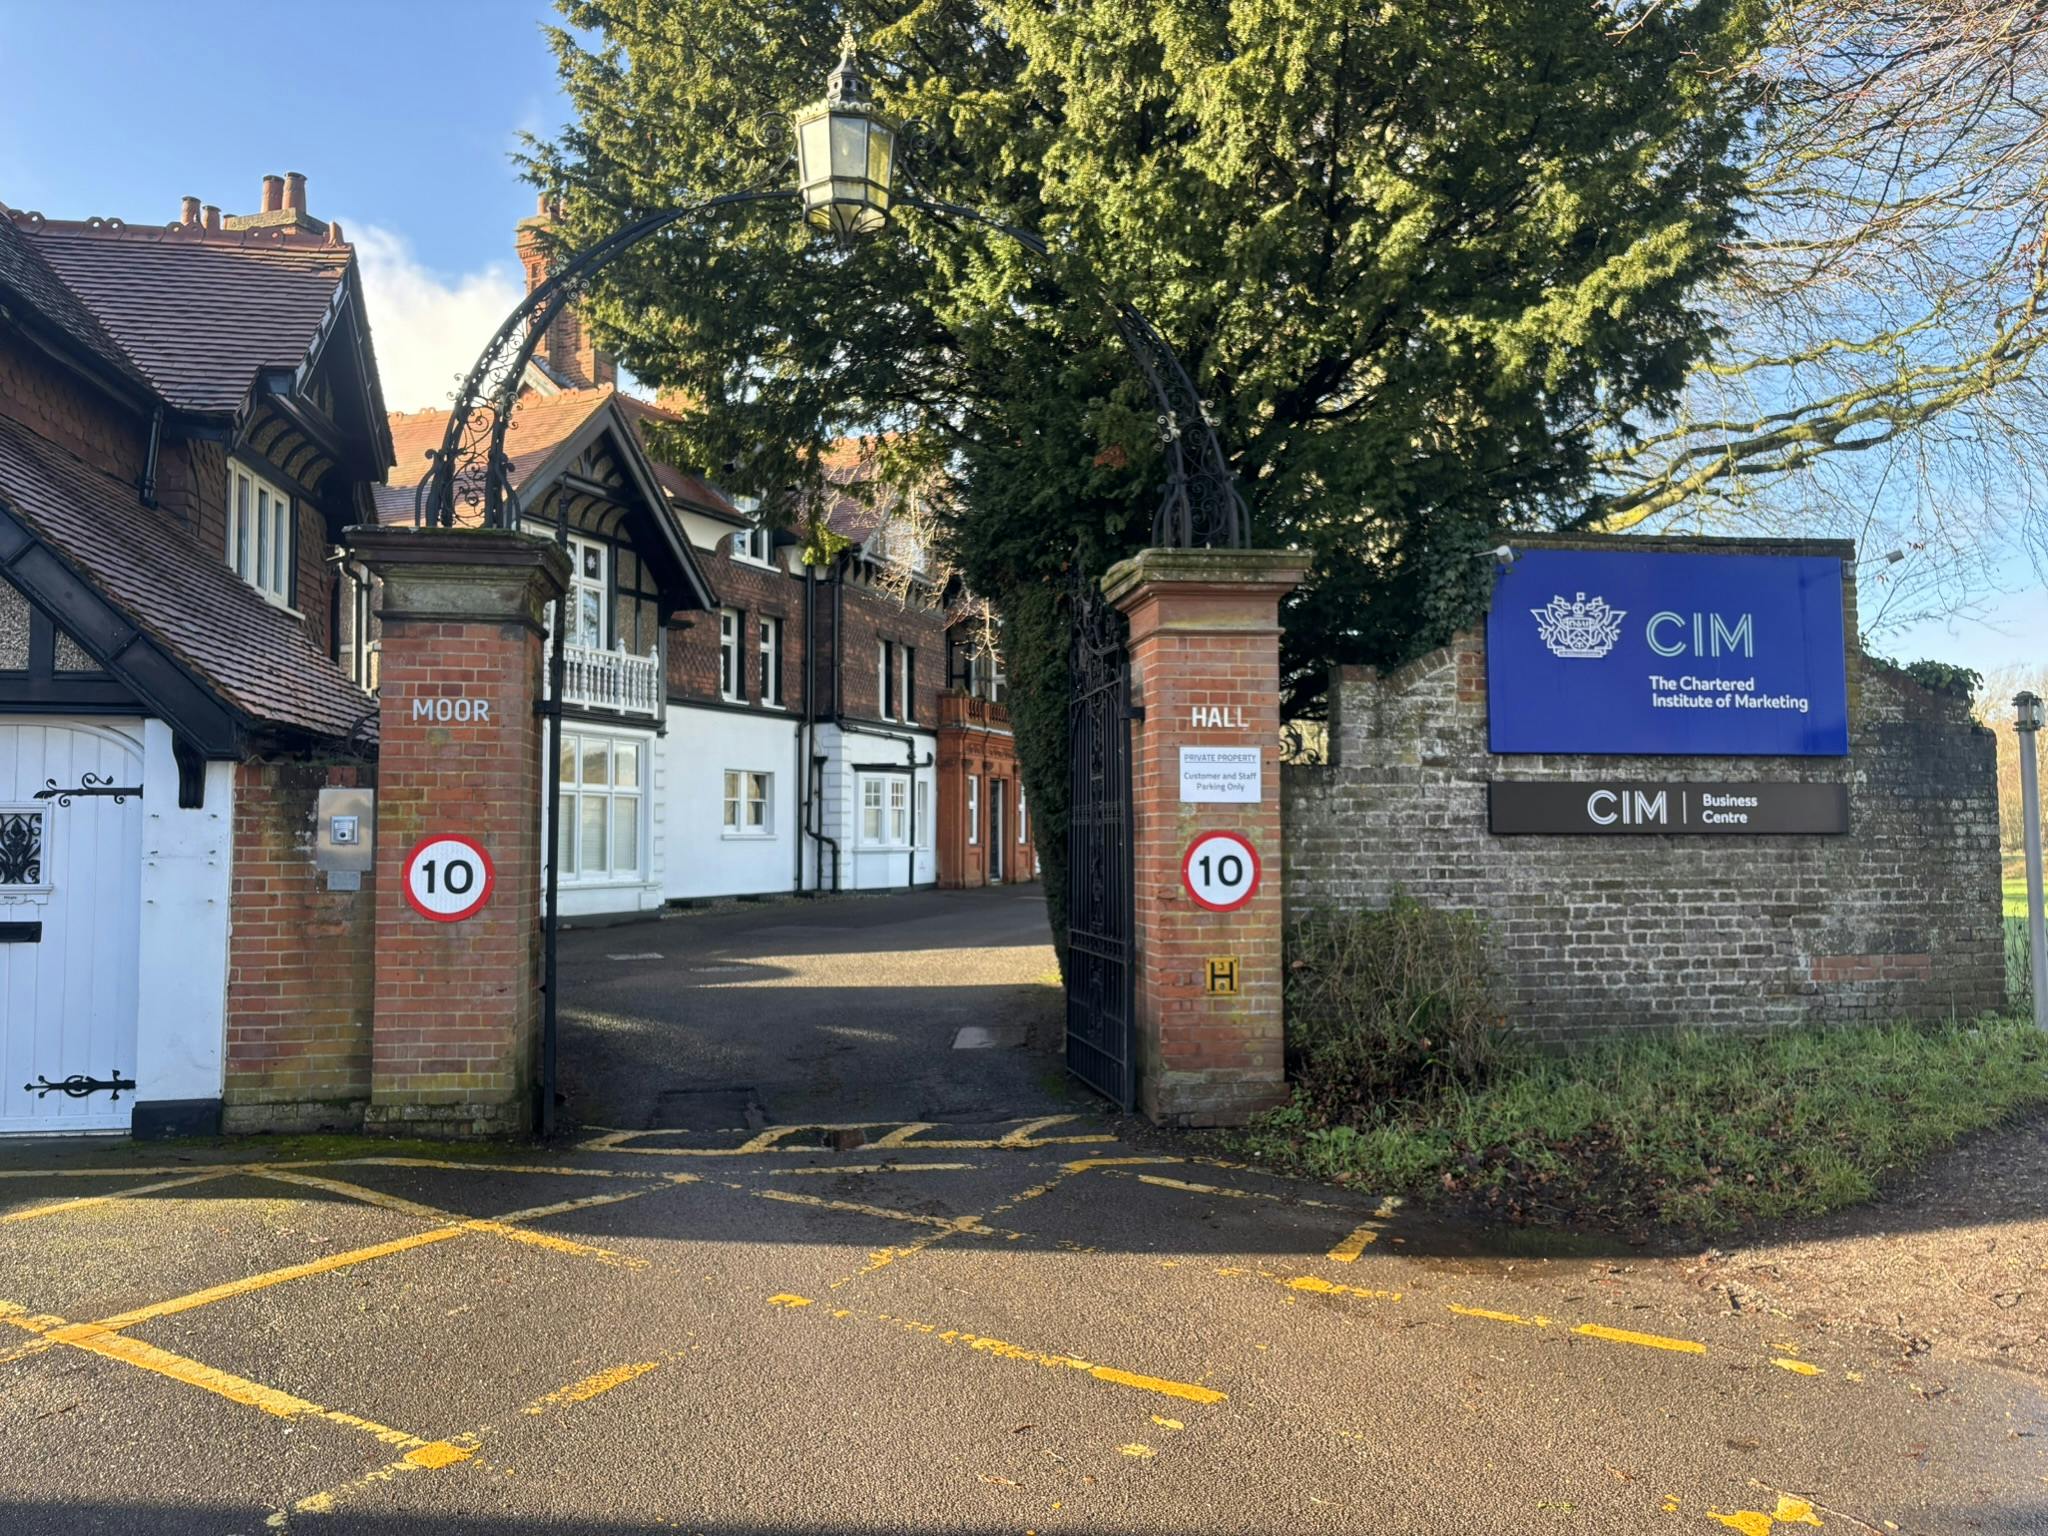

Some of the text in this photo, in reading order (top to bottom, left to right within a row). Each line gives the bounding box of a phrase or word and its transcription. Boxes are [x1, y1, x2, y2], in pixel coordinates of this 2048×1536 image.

[1646, 611, 1753, 658] CIM
[1649, 676, 1755, 691] The Chartered
[412, 698, 490, 722] MOOR
[1652, 693, 1809, 713] Institute of Marketing
[1191, 706, 1249, 728] HALL
[1184, 753, 1256, 762] PRIVATE PROPERTY
[1184, 772, 1257, 780] Customer and Staff
[1196, 783, 1245, 792] Parking Only
[1587, 790, 1667, 825] CIM
[1702, 793, 1758, 807] Business
[1702, 810, 1748, 824] Centre
[422, 859, 474, 895] 10
[1199, 855, 1243, 887] 10
